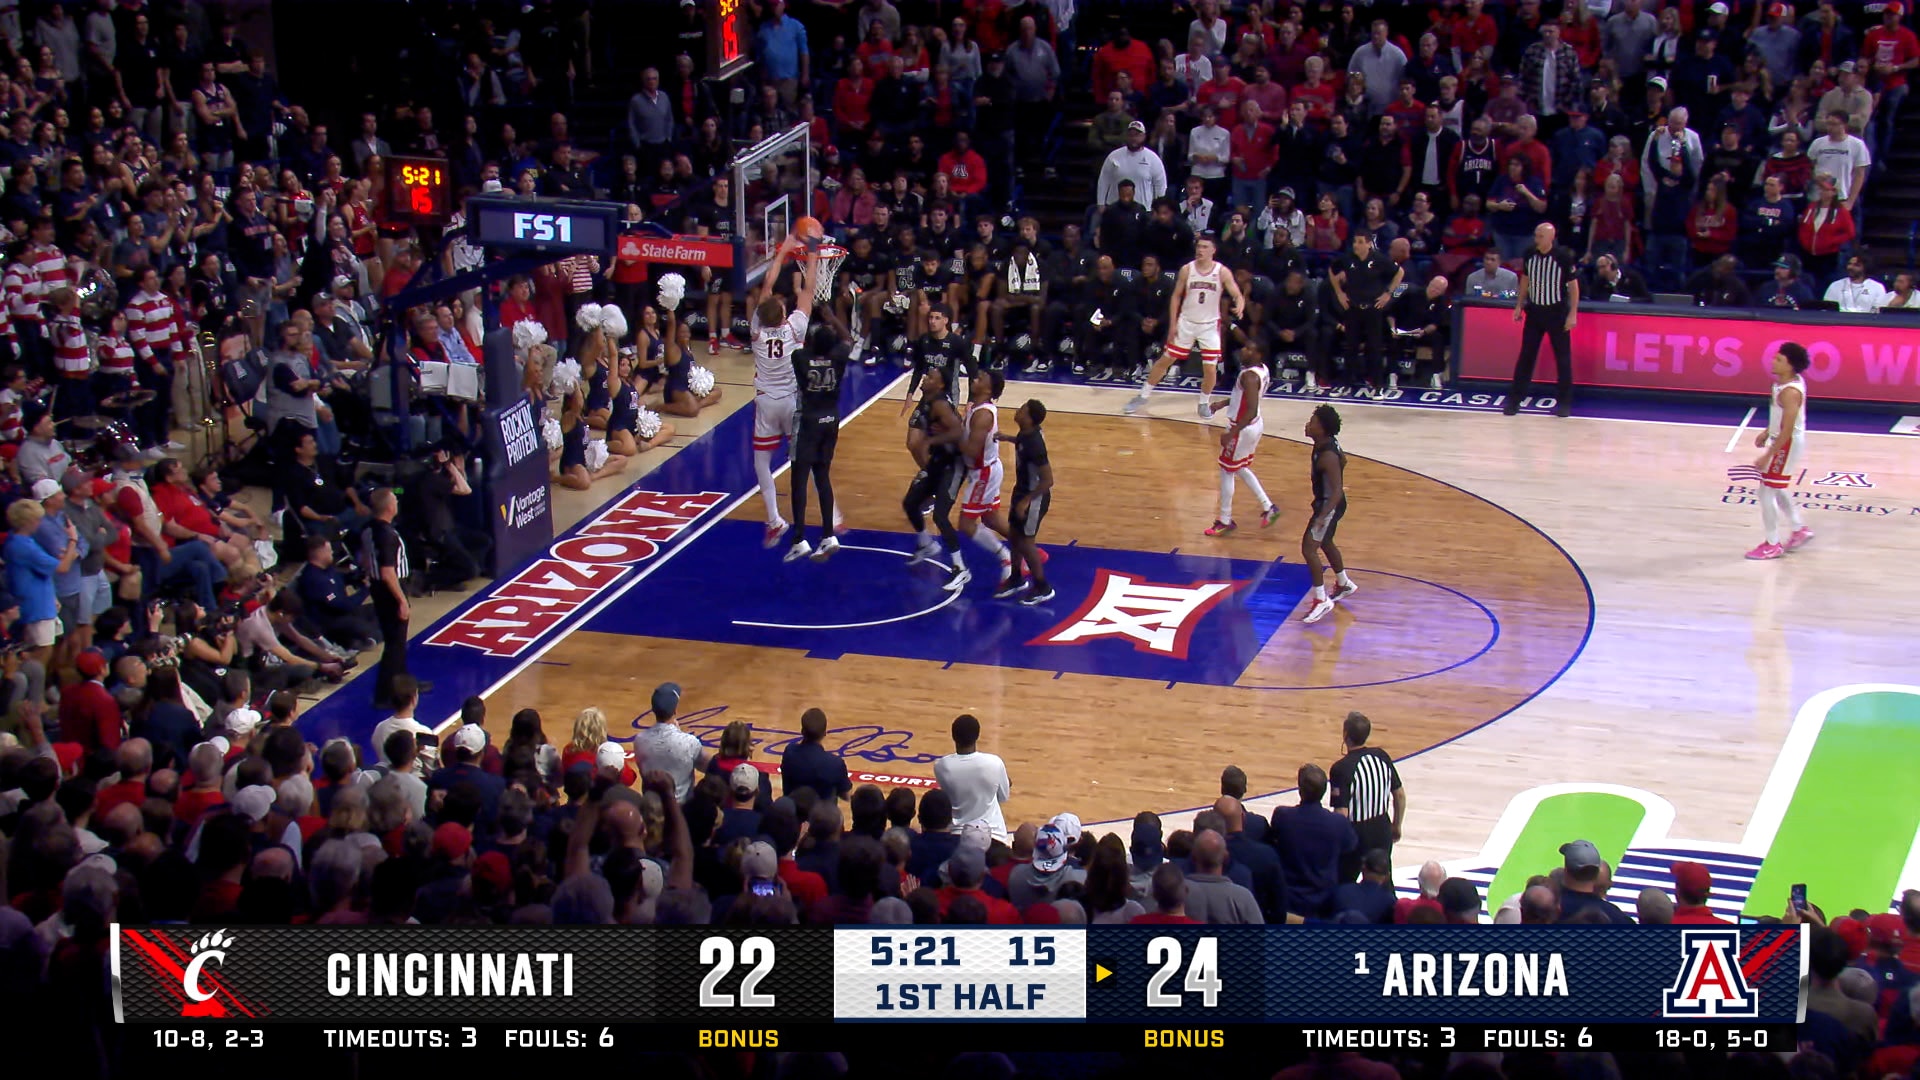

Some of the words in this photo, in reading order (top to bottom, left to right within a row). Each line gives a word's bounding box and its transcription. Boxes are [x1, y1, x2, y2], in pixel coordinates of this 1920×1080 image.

[402, 166, 441, 185] 5:21
[411, 187, 433, 214] 15
[514, 212, 572, 242] FS1
[765, 338, 784, 359] 13
[1861, 343, 1920, 385] W
[806, 367, 838, 392] 24
[501, 403, 534, 445] ROCKIN
[506, 428, 539, 467] PROTEIN
[515, 485, 546, 513] Vantage
[1721, 495, 1897, 516] Unersity
[515, 505, 535, 529] West
[422, 489, 731, 658] ARIZONA
[859, 773, 937, 787] COURT
